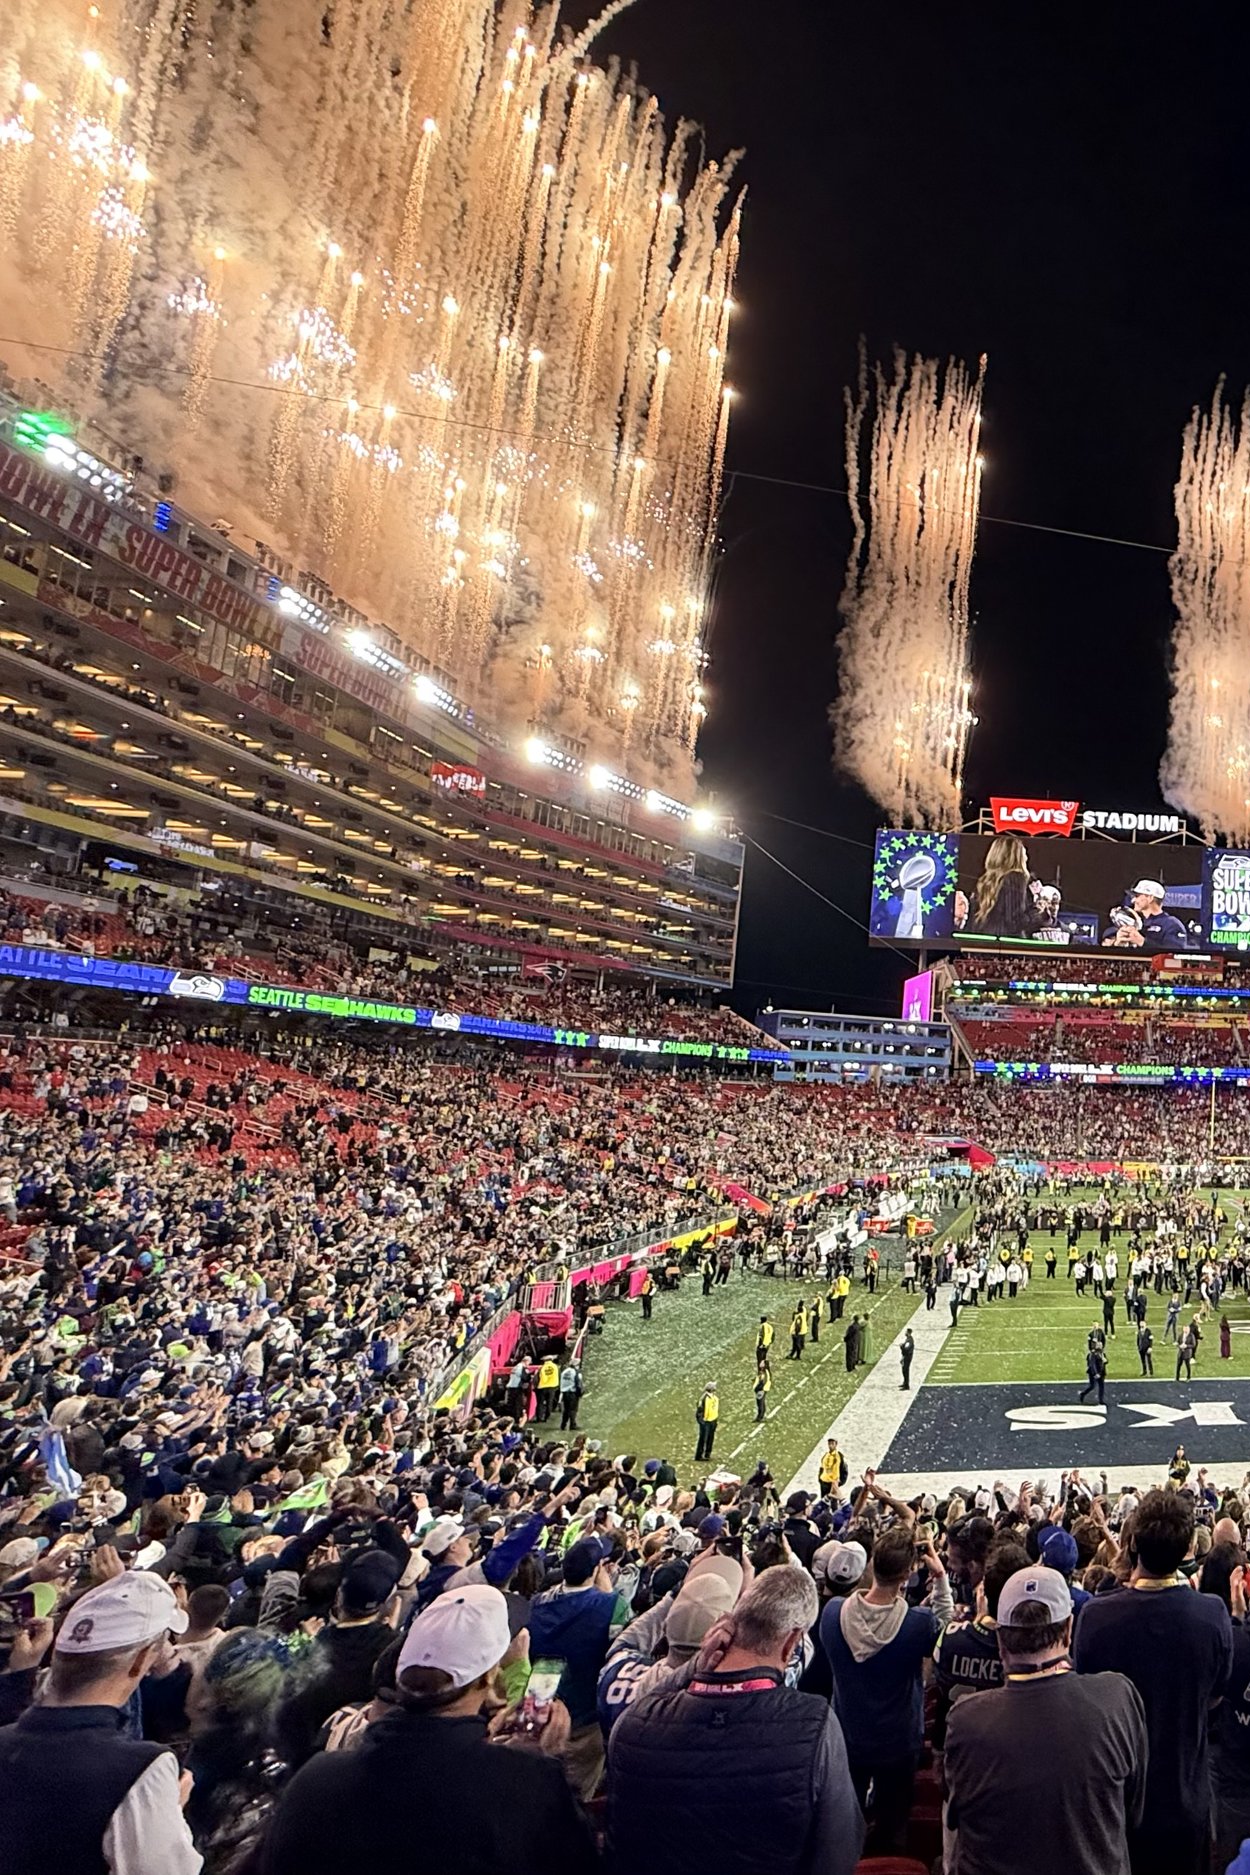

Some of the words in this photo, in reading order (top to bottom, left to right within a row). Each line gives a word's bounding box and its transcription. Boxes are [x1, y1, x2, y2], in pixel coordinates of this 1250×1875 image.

[118, 524, 202, 605] SUPER
[1082, 810, 1179, 833] STADIUM
[248, 986, 305, 1009] SEATTLE
[661, 1041, 714, 1057] CHAMPIONS
[1116, 1065, 1175, 1076] CHAMPIONS
[951, 1654, 1000, 1682] LOCKE
